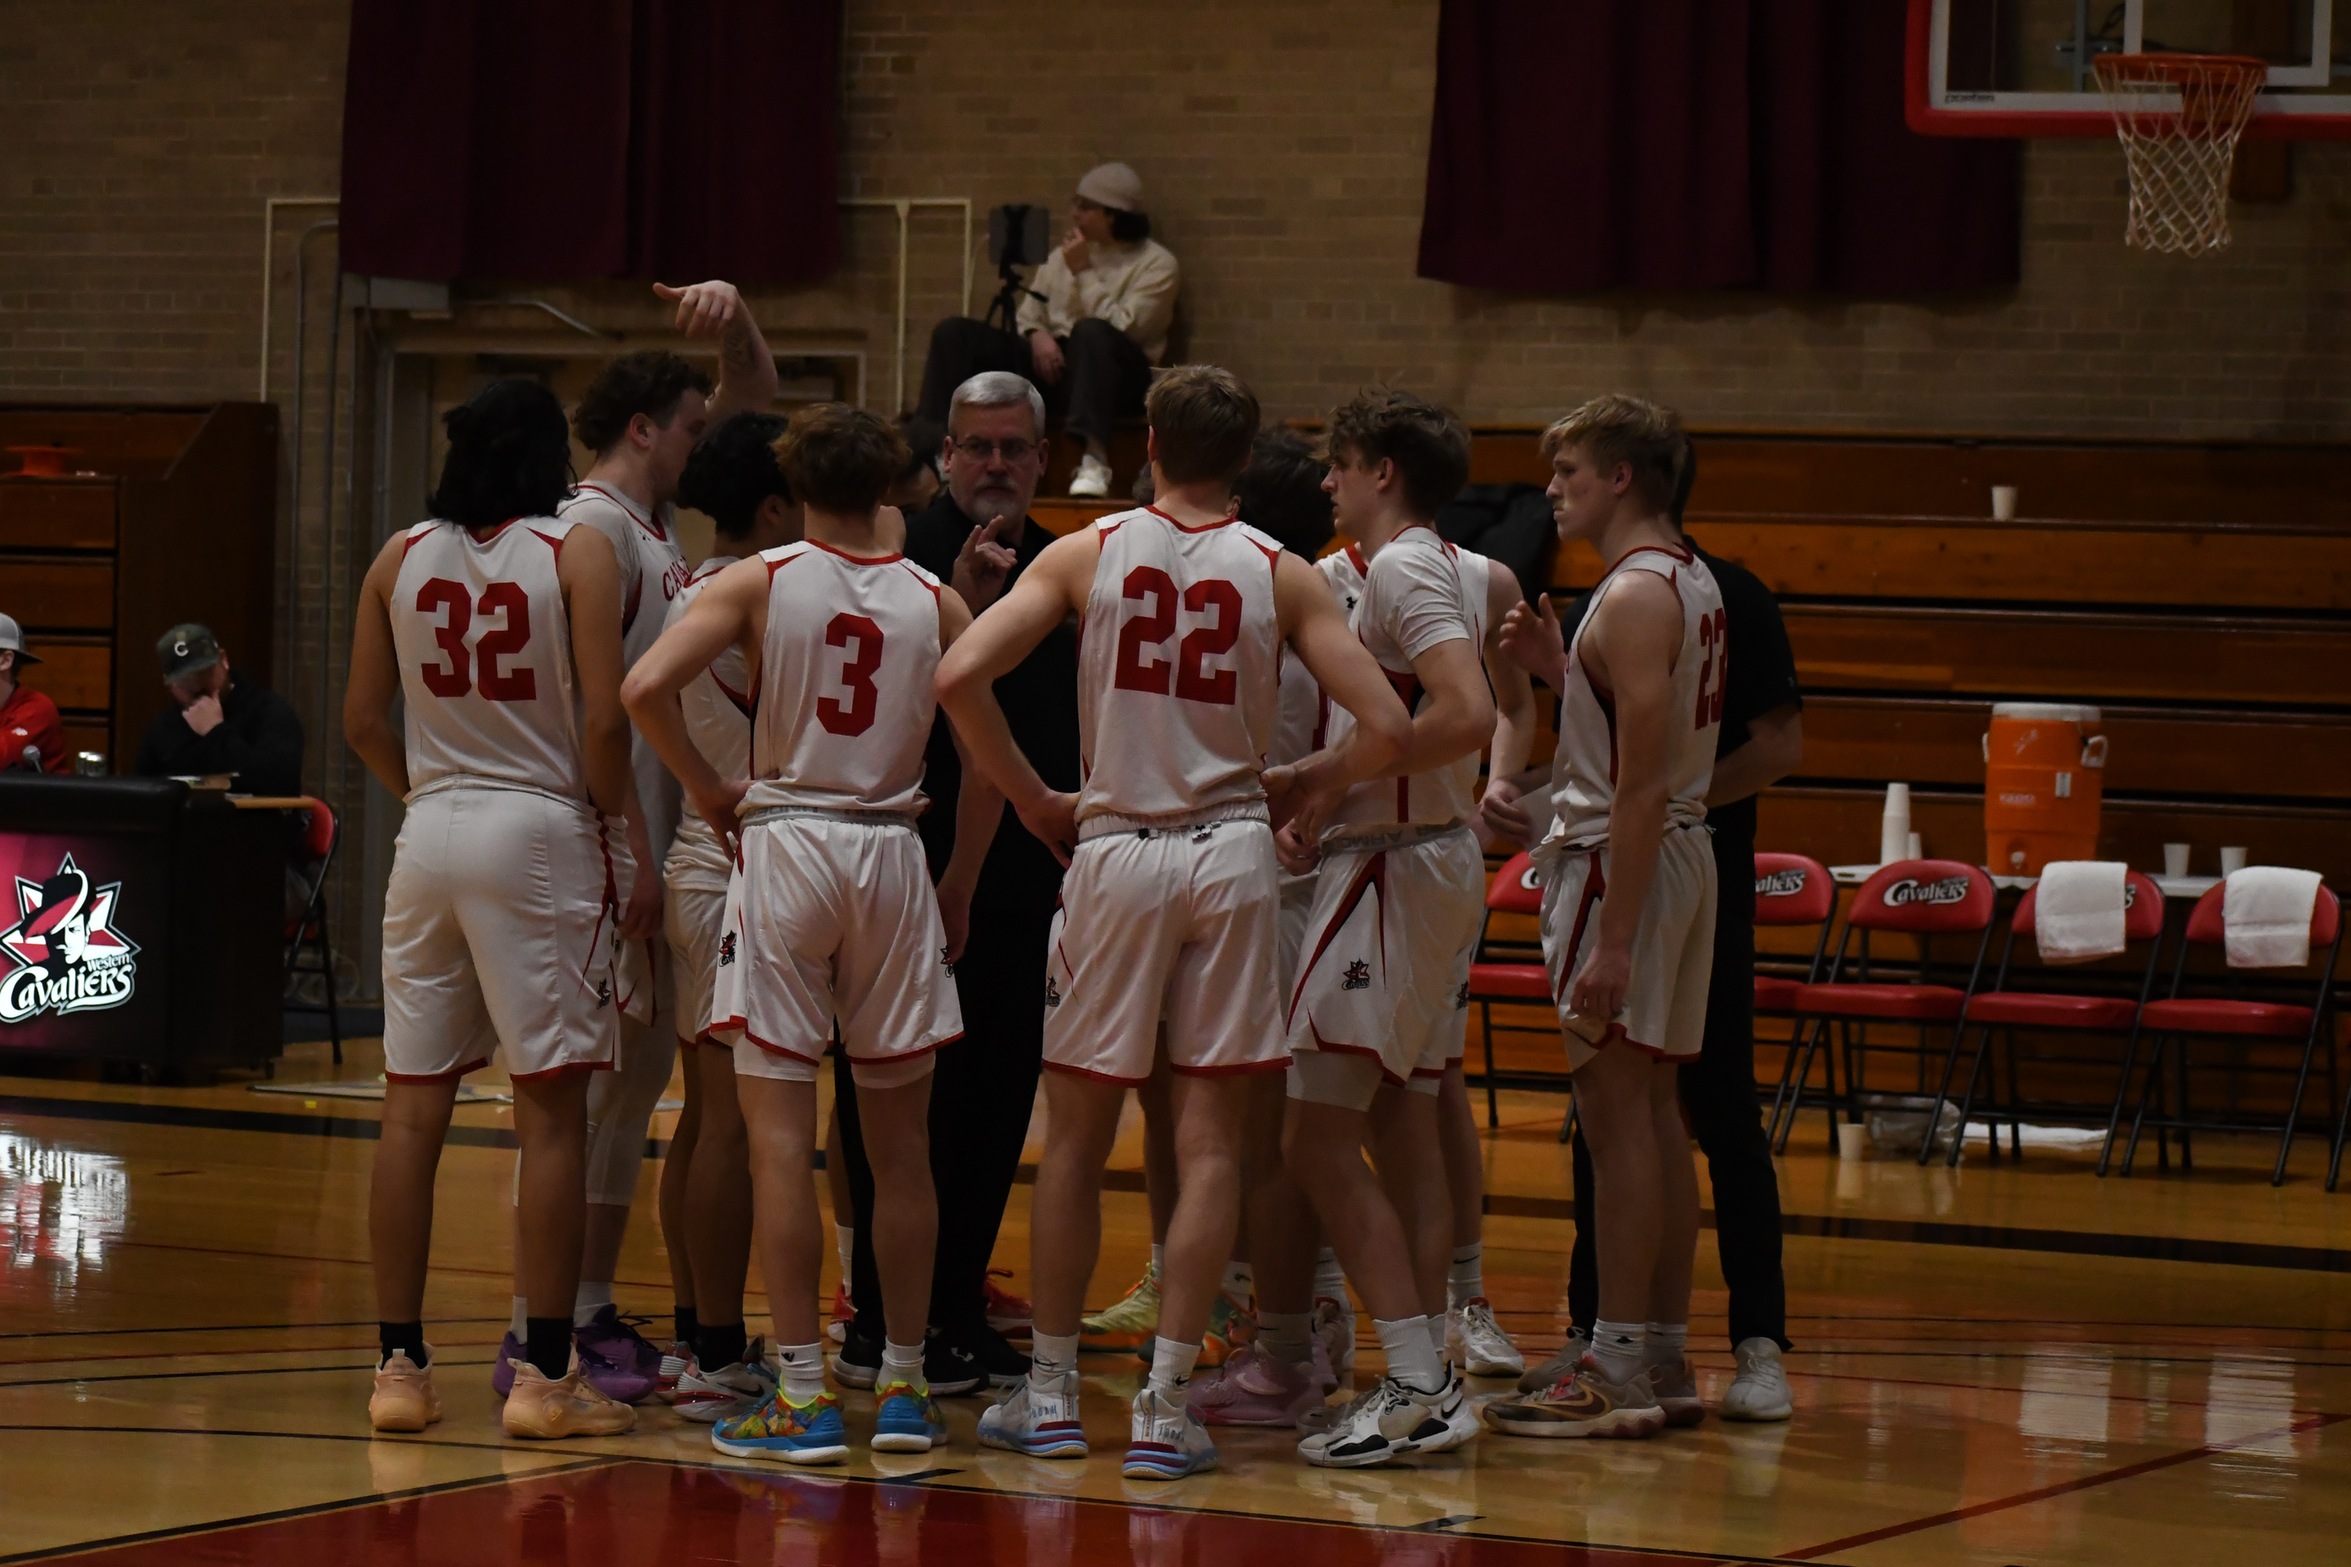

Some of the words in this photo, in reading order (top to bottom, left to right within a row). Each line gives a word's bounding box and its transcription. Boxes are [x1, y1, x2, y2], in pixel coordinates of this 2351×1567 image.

[174, 640, 189, 657] C
[416, 577, 537, 701] 32
[816, 612, 884, 737] 3
[1114, 565, 1243, 705] 22
[87, 952, 130, 972] Western
